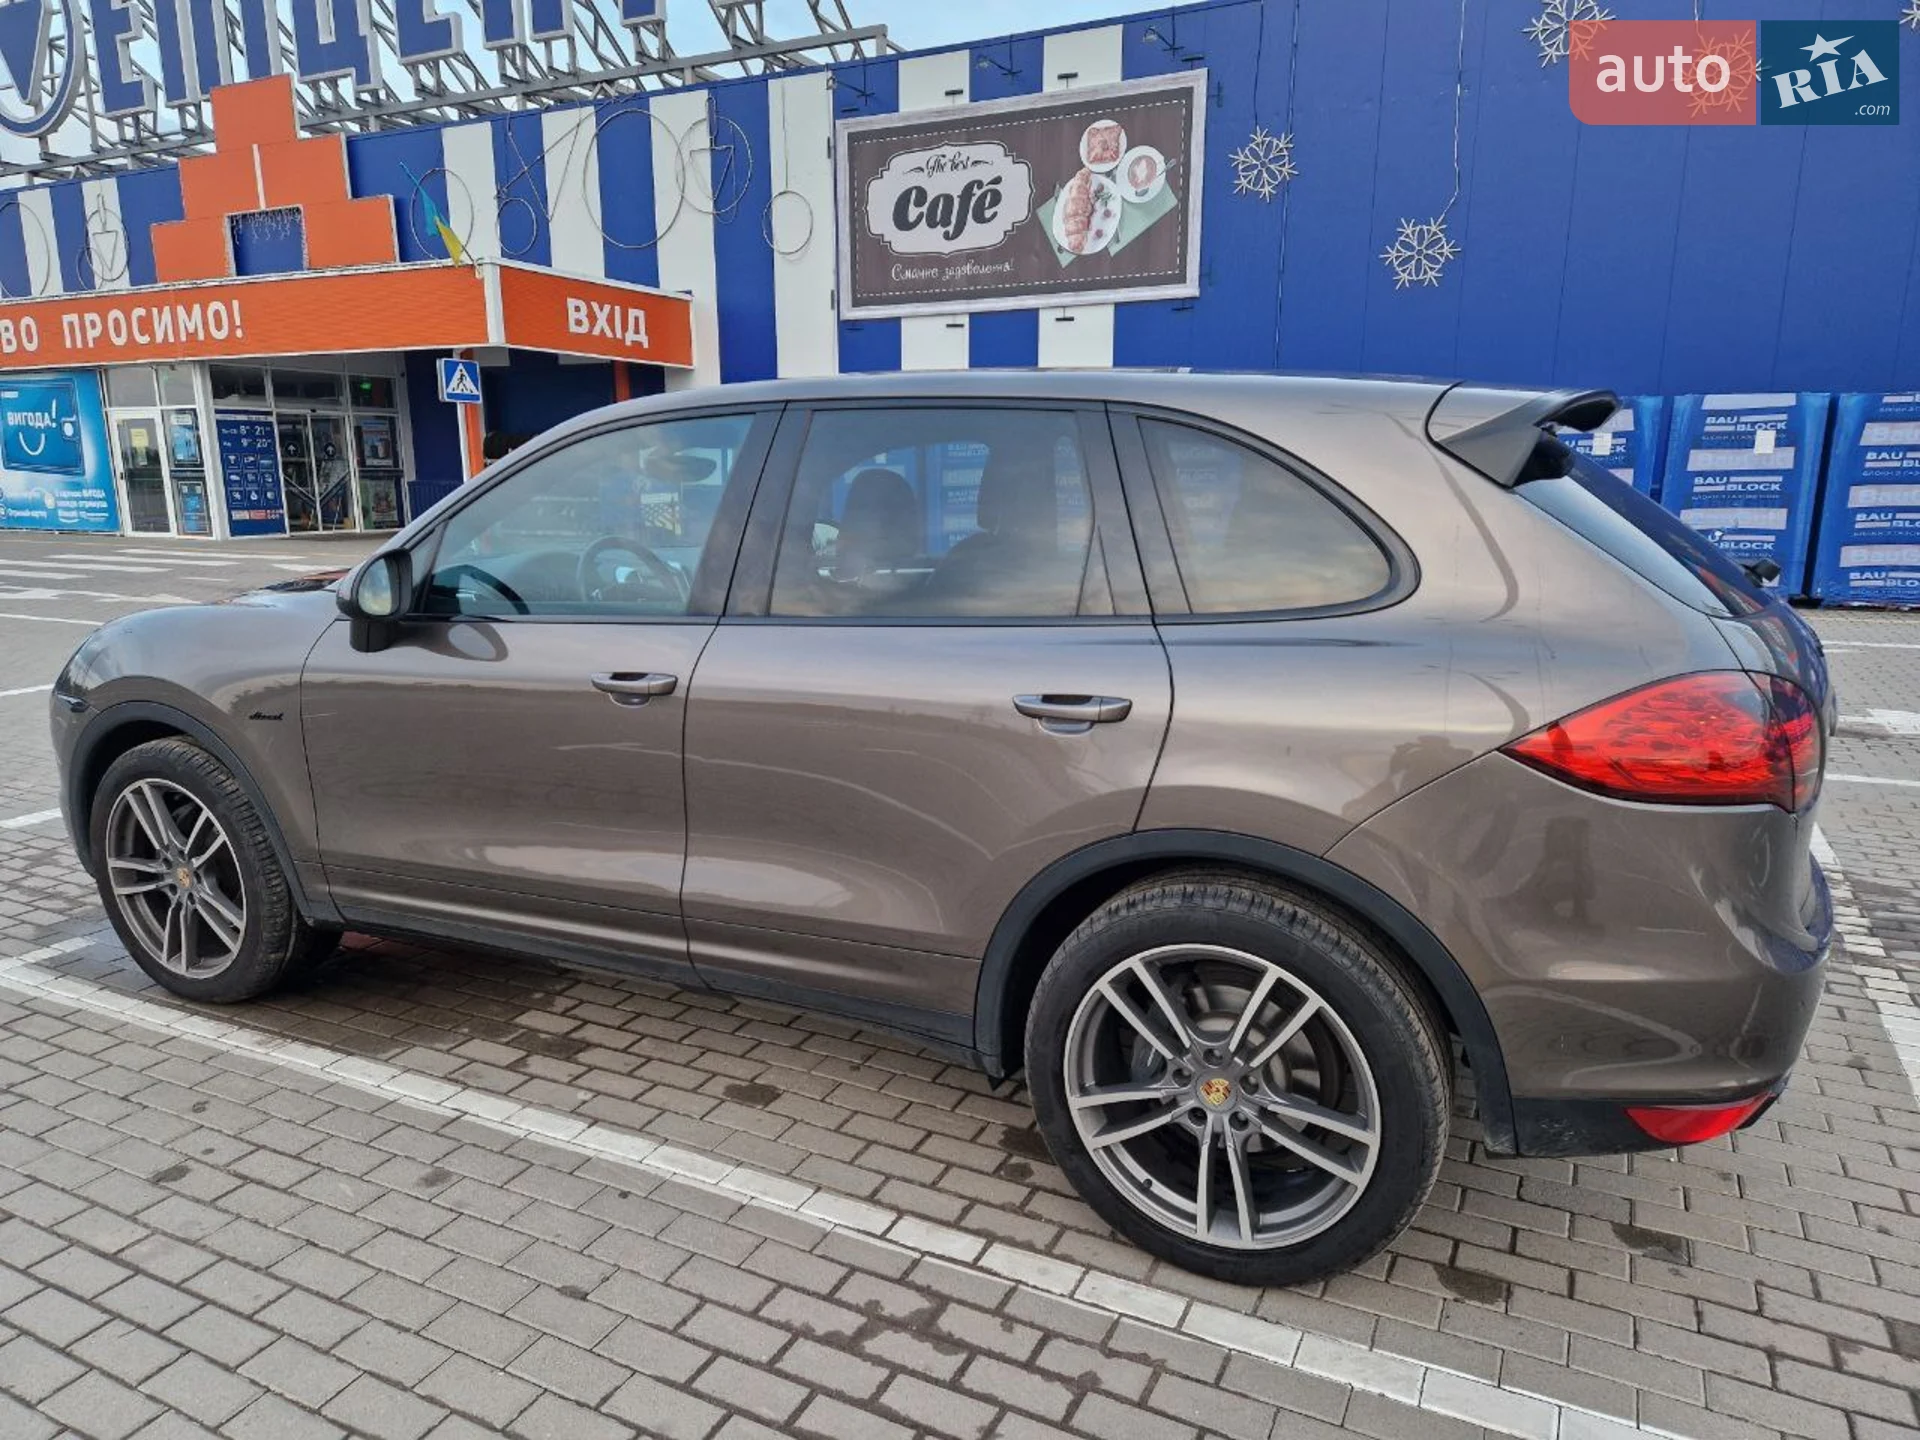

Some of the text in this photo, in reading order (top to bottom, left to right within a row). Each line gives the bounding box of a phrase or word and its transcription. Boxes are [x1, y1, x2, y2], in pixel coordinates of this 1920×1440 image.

[949, 151, 970, 172] best
[892, 175, 1003, 241] Café
[61, 299, 244, 349] ПРОСИМО!
[566, 296, 649, 349] ВХІД
[7, 399, 57, 429] ВИГОДА!
[1706, 416, 1738, 424] BAU
[1736, 422, 1787, 432] BLOCK
[1865, 451, 1903, 460] BAU
[1694, 476, 1727, 485] BAU
[1726, 483, 1781, 491] BLOCK
[1856, 513, 1893, 521] BAU
[1719, 542, 1775, 550] BLOCK
[1849, 572, 1886, 580] BAU
